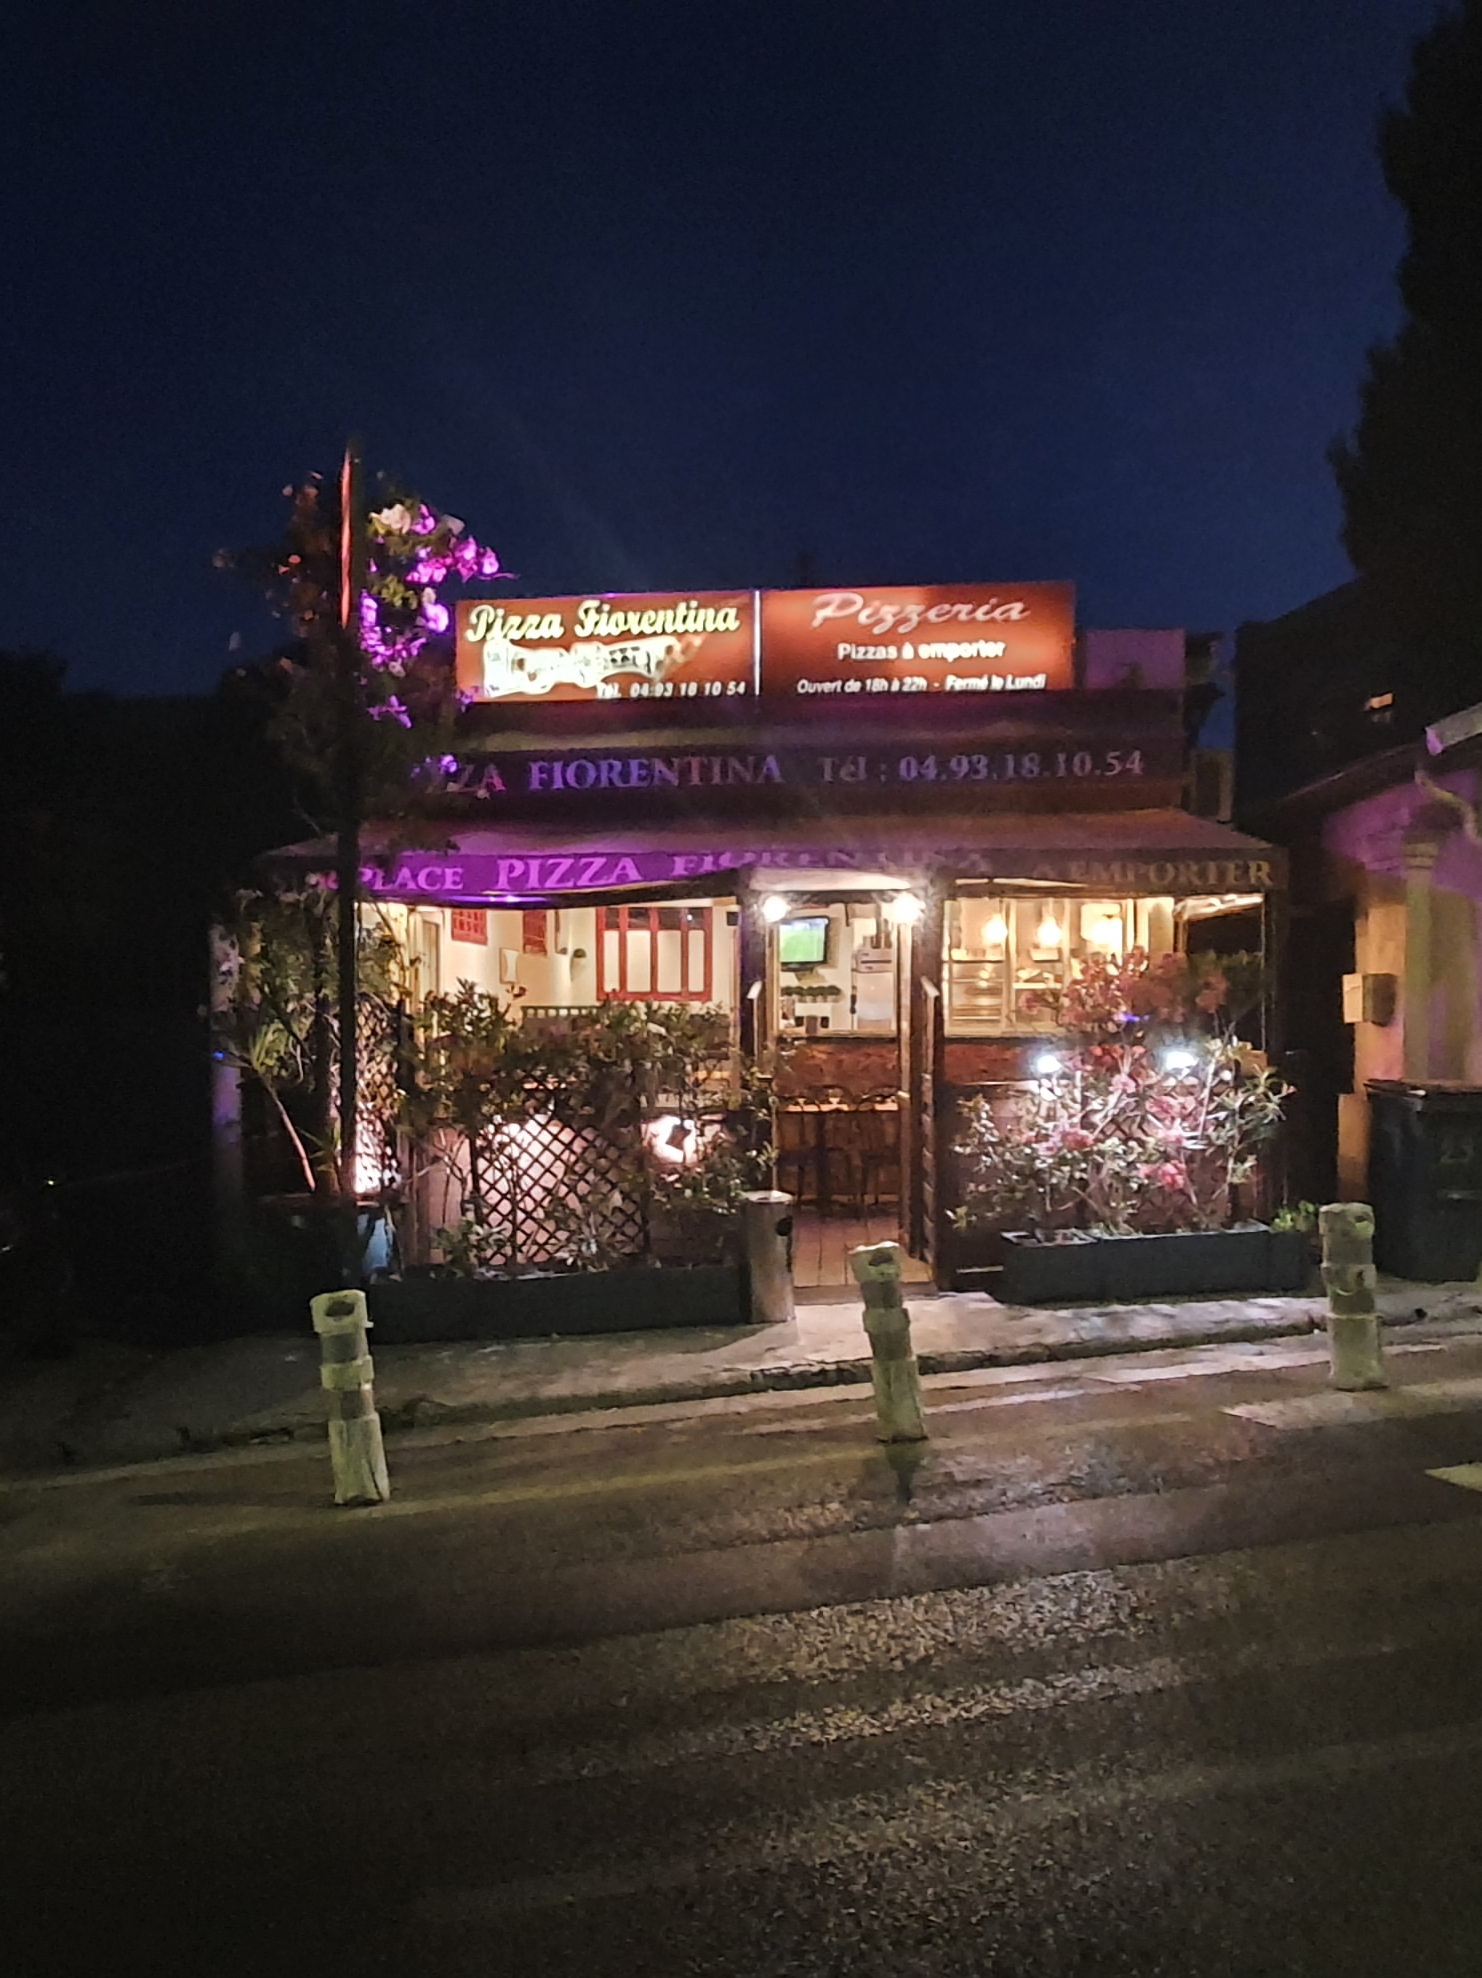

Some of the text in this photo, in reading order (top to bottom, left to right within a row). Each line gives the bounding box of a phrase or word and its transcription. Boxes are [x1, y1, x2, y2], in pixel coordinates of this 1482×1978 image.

[465, 600, 740, 642] Pizza Fiorentina
[811, 592, 1030, 634] Pizzeria
[838, 642, 897, 661] Pizzas
[918, 640, 1006, 662] emporter
[630, 682, 649, 698] 04
[654, 682, 674, 698] 93
[679, 681, 698, 697] 18
[704, 681, 722, 696] 10
[727, 680, 746, 696] 54
[797, 679, 842, 694] Ouvert
[844, 678, 862, 693] de
[865, 677, 888, 693] 18h
[902, 676, 928, 692] 22h
[1005, 673, 1047, 690] Lundi
[528, 755, 785, 791] FIORENTINA
[497, 856, 642, 891] PIZZA
[1069, 859, 1273, 886] EMPORTER
